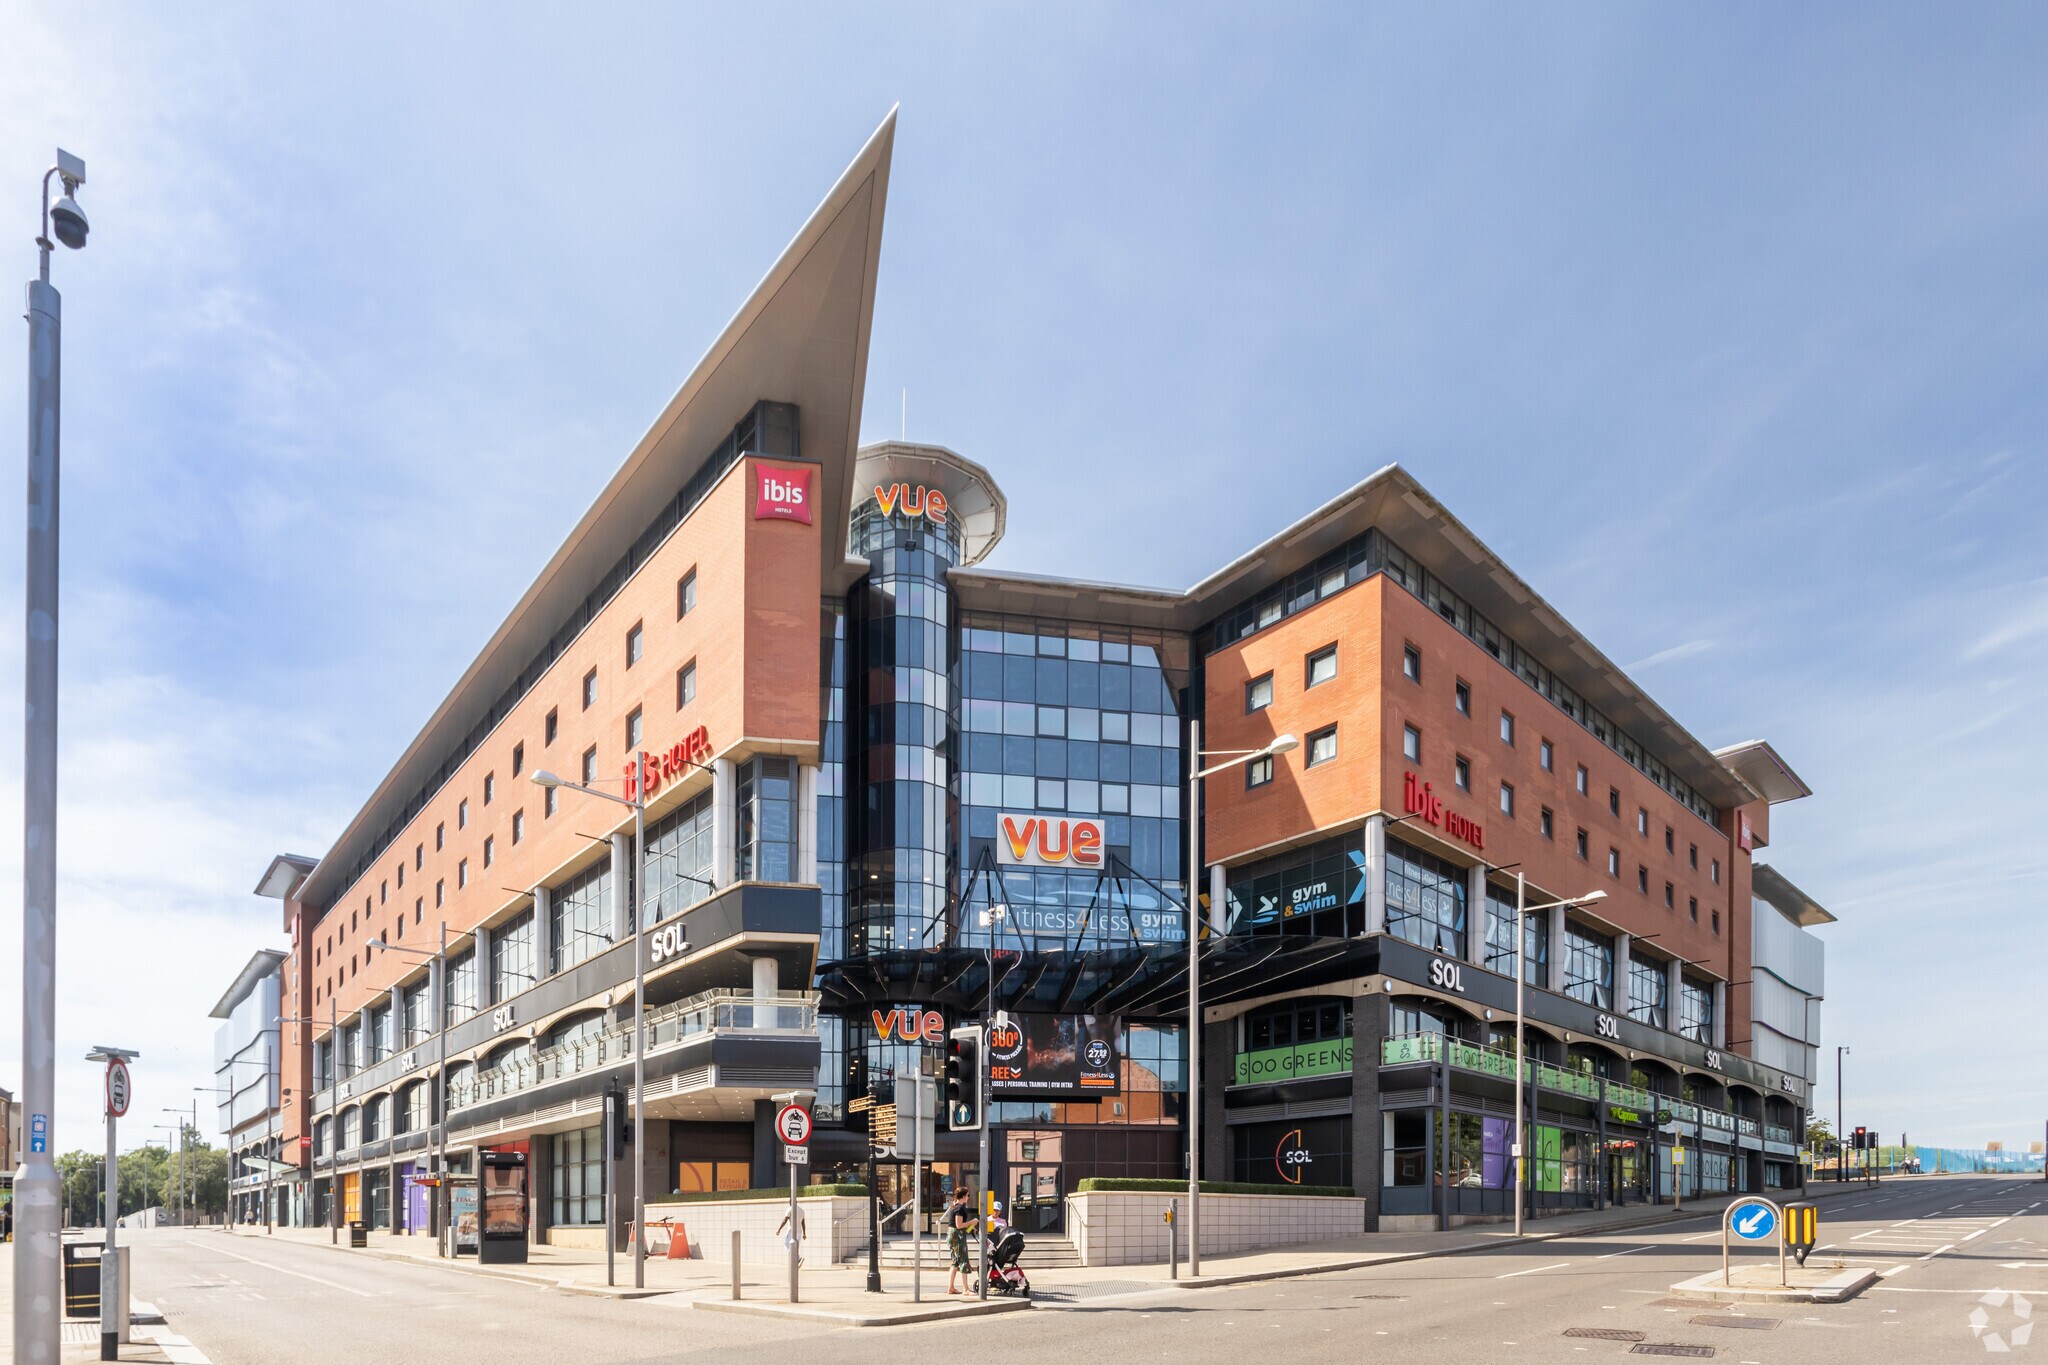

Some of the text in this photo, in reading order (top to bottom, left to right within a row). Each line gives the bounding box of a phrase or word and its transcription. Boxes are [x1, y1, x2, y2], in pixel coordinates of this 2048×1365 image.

[763, 478, 804, 505] ibis
[873, 482, 948, 524] vue
[662, 725, 712, 779] HOTEL
[1404, 771, 1485, 850] ibis HOTEL
[1003, 815, 1101, 864] vue
[1292, 881, 1327, 904] gym
[1294, 894, 1337, 915] swim
[1006, 905, 1129, 932] Fitness4Less
[1141, 913, 1177, 927] gym
[652, 922, 691, 963] SOL
[1143, 926, 1187, 940] swim
[1431, 958, 1465, 993] SOL
[493, 1004, 518, 1033] SOL
[872, 1009, 945, 1042] vue
[1598, 1013, 1620, 1040] SOL
[402, 1051, 418, 1073] SOL
[991, 1066, 1010, 1079] REE
[1239, 1048, 1353, 1076] SOO GREENS
[1706, 1049, 1722, 1070] SOL
[1122, 1080, 1177, 1091] FTNESS
[1782, 1075, 1795, 1093] SOL
[1286, 1150, 1312, 1164] SOL
